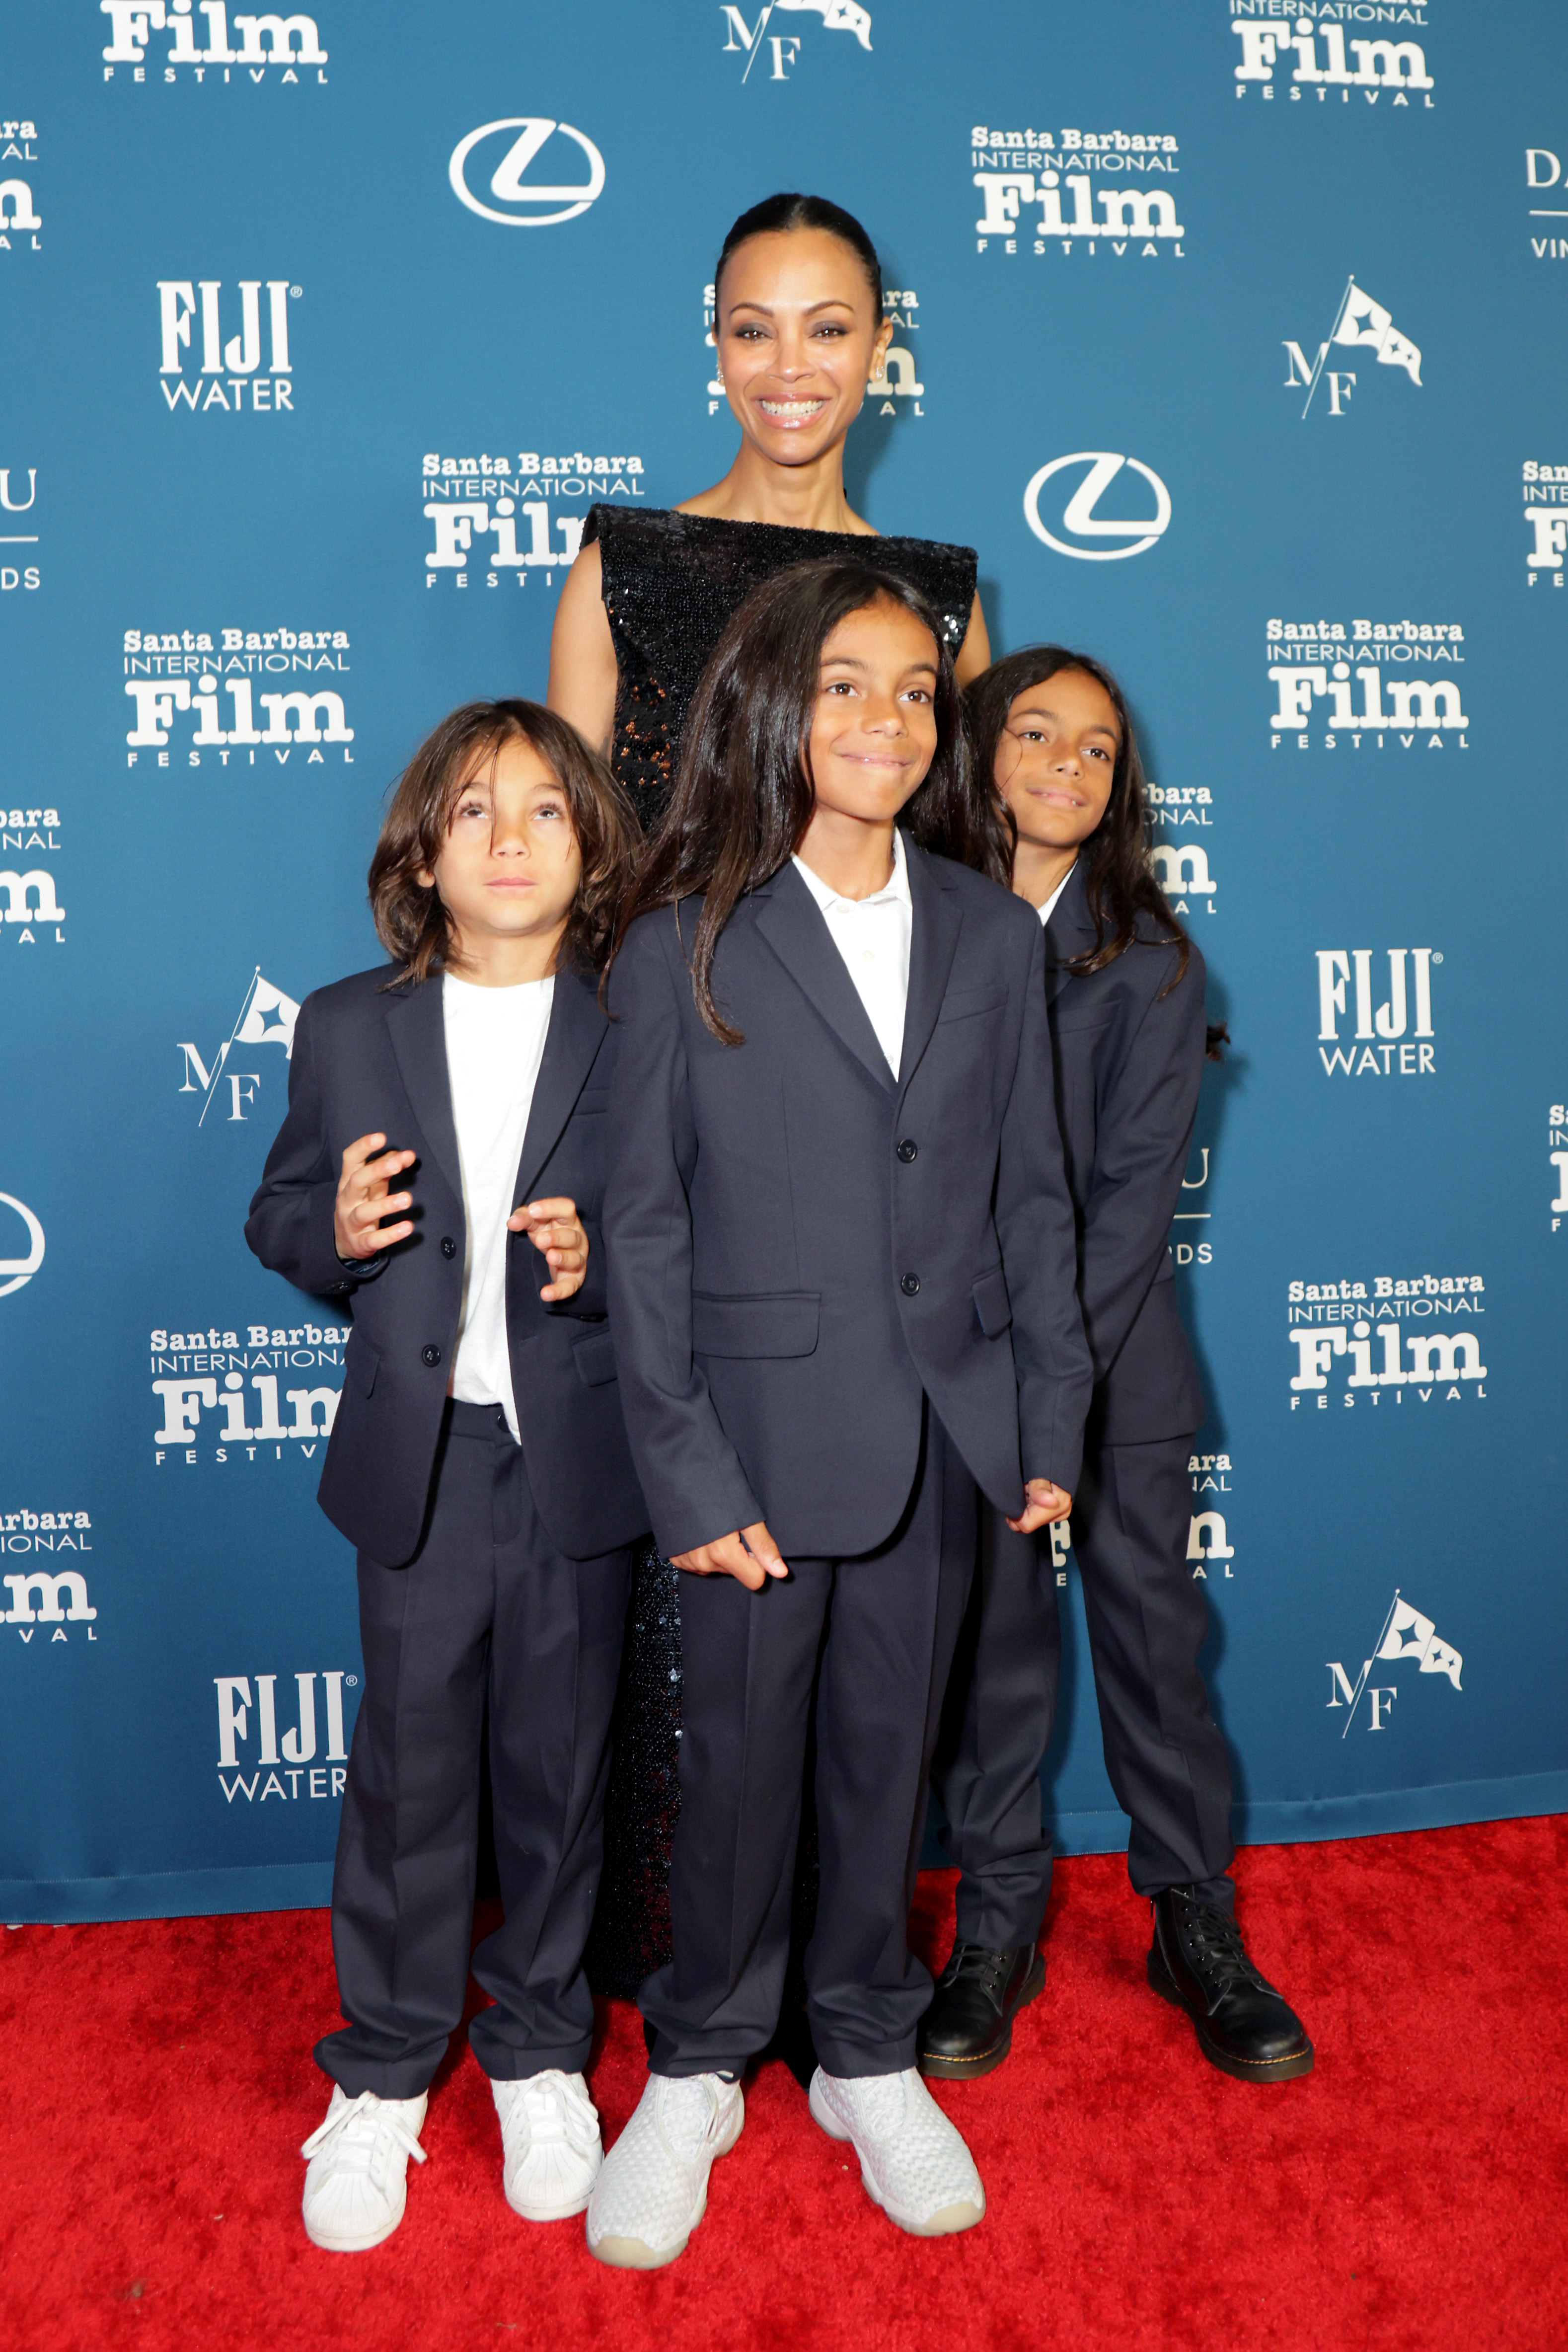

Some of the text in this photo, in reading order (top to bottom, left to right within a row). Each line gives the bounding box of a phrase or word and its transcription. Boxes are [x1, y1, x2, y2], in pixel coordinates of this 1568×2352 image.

[1231, 0, 1427, 26] INTERNATIONAL
[100, 0, 328, 64] Film
[1232, 17, 1434, 90] Film
[104, 67, 327, 83] FESTIVAL
[1236, 85, 1434, 107] FESTIVAL
[972, 127, 1178, 152] Santa Barbara
[972, 151, 1179, 172] INTERNATIONAL
[973, 169, 1185, 237] Film
[977, 239, 1184, 256] FESTIVAL
[161, 379, 294, 410] WATER
[423, 453, 644, 475] Santa Barbara
[423, 478, 644, 497] INTERNATIONAL
[427, 572, 551, 588] FESTI
[124, 628, 350, 652] Santa Barbara
[1267, 619, 1464, 641] Santa Barbara
[1268, 644, 1464, 661] INTERNATIONAL
[125, 654, 350, 677] INTERNATIONAL
[1269, 662, 1469, 729] Film
[125, 674, 354, 746] Film
[1271, 735, 1468, 748] FESTIVAL
[128, 749, 354, 767] FESTIVAL
[1146, 783, 1213, 804] bara
[1319, 1044, 1435, 1075] WATER
[1289, 1275, 1485, 1301] Santa Barbara
[1288, 1297, 1485, 1322] INTERNATIONAL
[151, 1324, 352, 1351] Santa Barbar
[150, 1350, 346, 1373] INTERNATION
[1289, 1320, 1488, 1390] Film
[1290, 1385, 1487, 1411] FESTIVAL
[155, 1444, 317, 1465] FESTIV
[0, 1509, 92, 1531] rbara
[219, 1768, 346, 1803] WATER
